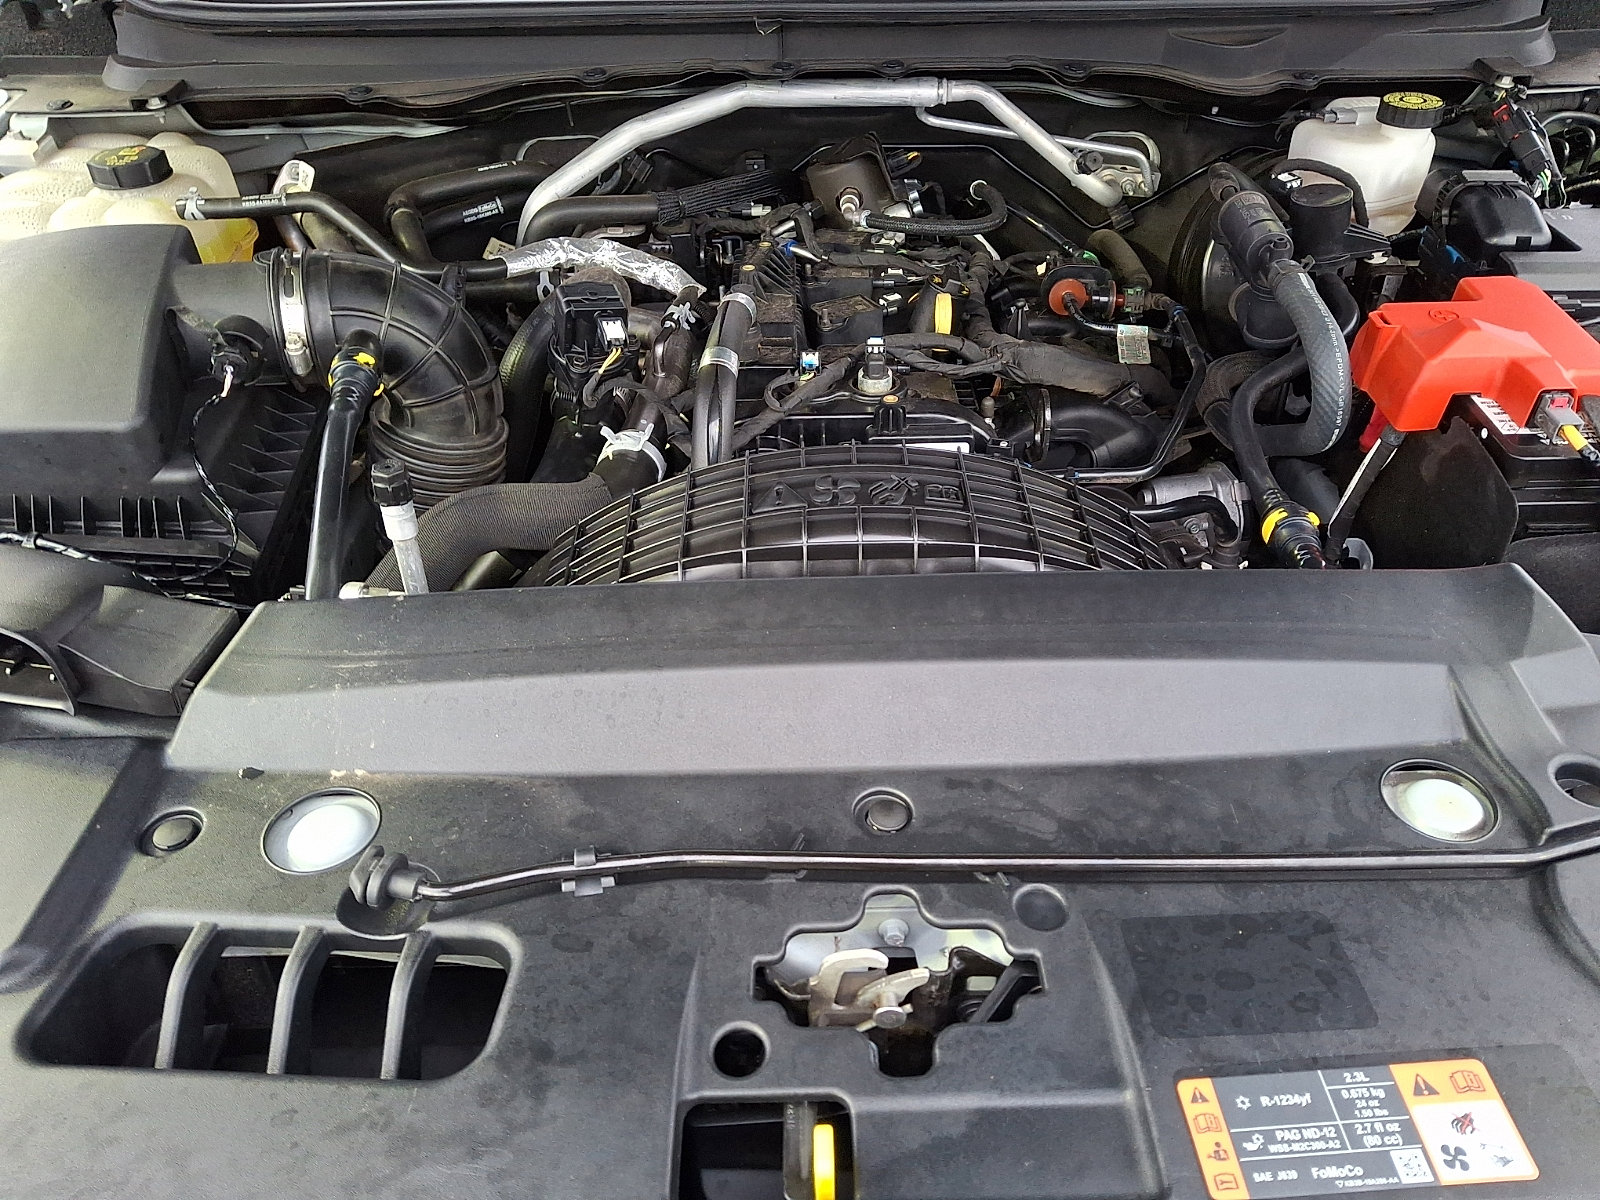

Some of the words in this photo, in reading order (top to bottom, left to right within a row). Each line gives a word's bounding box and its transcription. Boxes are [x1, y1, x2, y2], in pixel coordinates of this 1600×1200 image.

[1344, 1072, 1370, 1083] 2.3L
[1260, 1093, 1312, 1107] R-1234yf
[1342, 1088, 1370, 1099] 0.675
[1370, 1088, 1386, 1099] kg
[1276, 1130, 1301, 1141] PAG
[1302, 1127, 1337, 1139] ND-12
[1355, 1124, 1371, 1135] 2.7
[1386, 1123, 1401, 1132] oz
[1363, 1135, 1382, 1148] (80
[1383, 1133, 1403, 1146] cc)
[1253, 1172, 1274, 1183] SAE
[1311, 1165, 1364, 1180] FoMoCo
